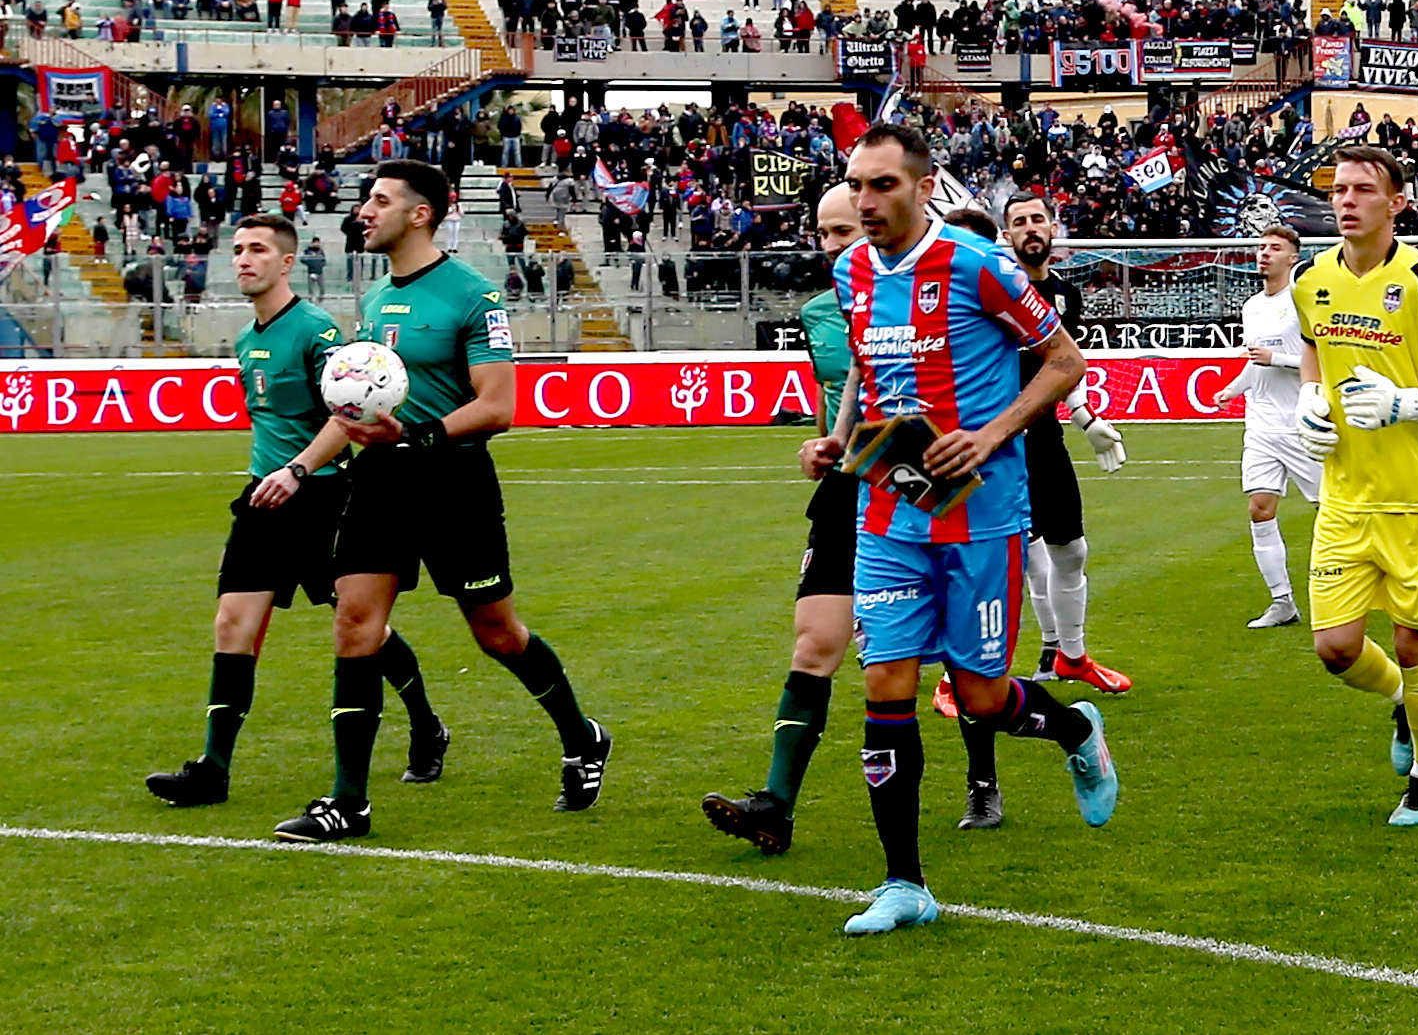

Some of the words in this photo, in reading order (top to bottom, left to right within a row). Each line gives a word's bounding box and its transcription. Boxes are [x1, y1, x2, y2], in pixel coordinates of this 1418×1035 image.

[583, 50, 607, 59] VIVE
[846, 41, 885, 52] Ultras
[846, 56, 884, 67] Ghetto
[1362, 66, 1409, 84] VIVE
[1331, 313, 1381, 330] SUPER
[863, 325, 917, 342] SUPER
[1313, 323, 1403, 346] Conveniente
[855, 335, 946, 357] onveniente
[1084, 365, 1223, 414] BAC
[47, 375, 238, 425] BACC
[976, 598, 1003, 640] 10
